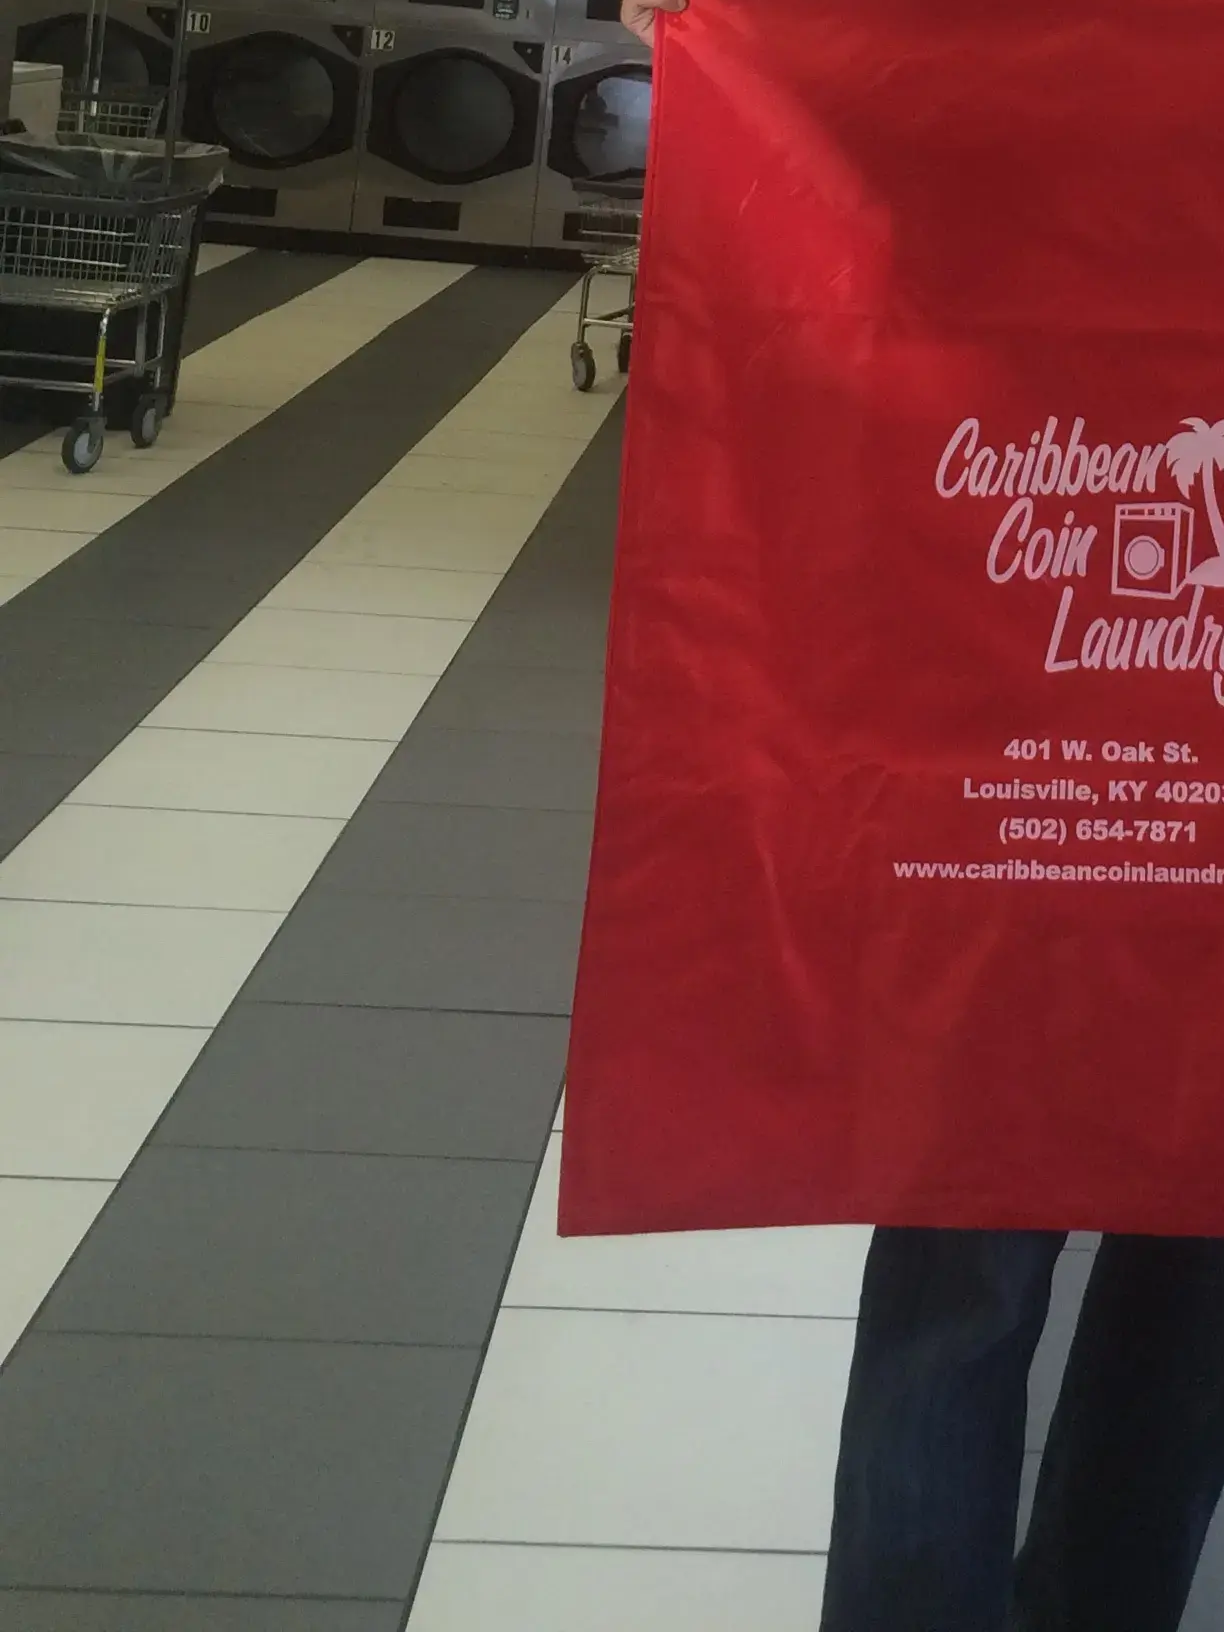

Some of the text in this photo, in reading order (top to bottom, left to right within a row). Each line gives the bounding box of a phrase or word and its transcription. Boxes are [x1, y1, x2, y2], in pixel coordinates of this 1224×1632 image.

[190, 13, 208, 32] 10
[375, 31, 392, 49] 12
[554, 46, 571, 64] 14
[935, 415, 1168, 499] Caribbean
[986, 497, 1098, 584] Coin
[1003, 739, 1200, 764] 401 W. Oak St.
[963, 777, 1099, 806] Louisville,
[1108, 780, 1148, 802] KY
[998, 817, 1197, 845] (502) 654-7871
